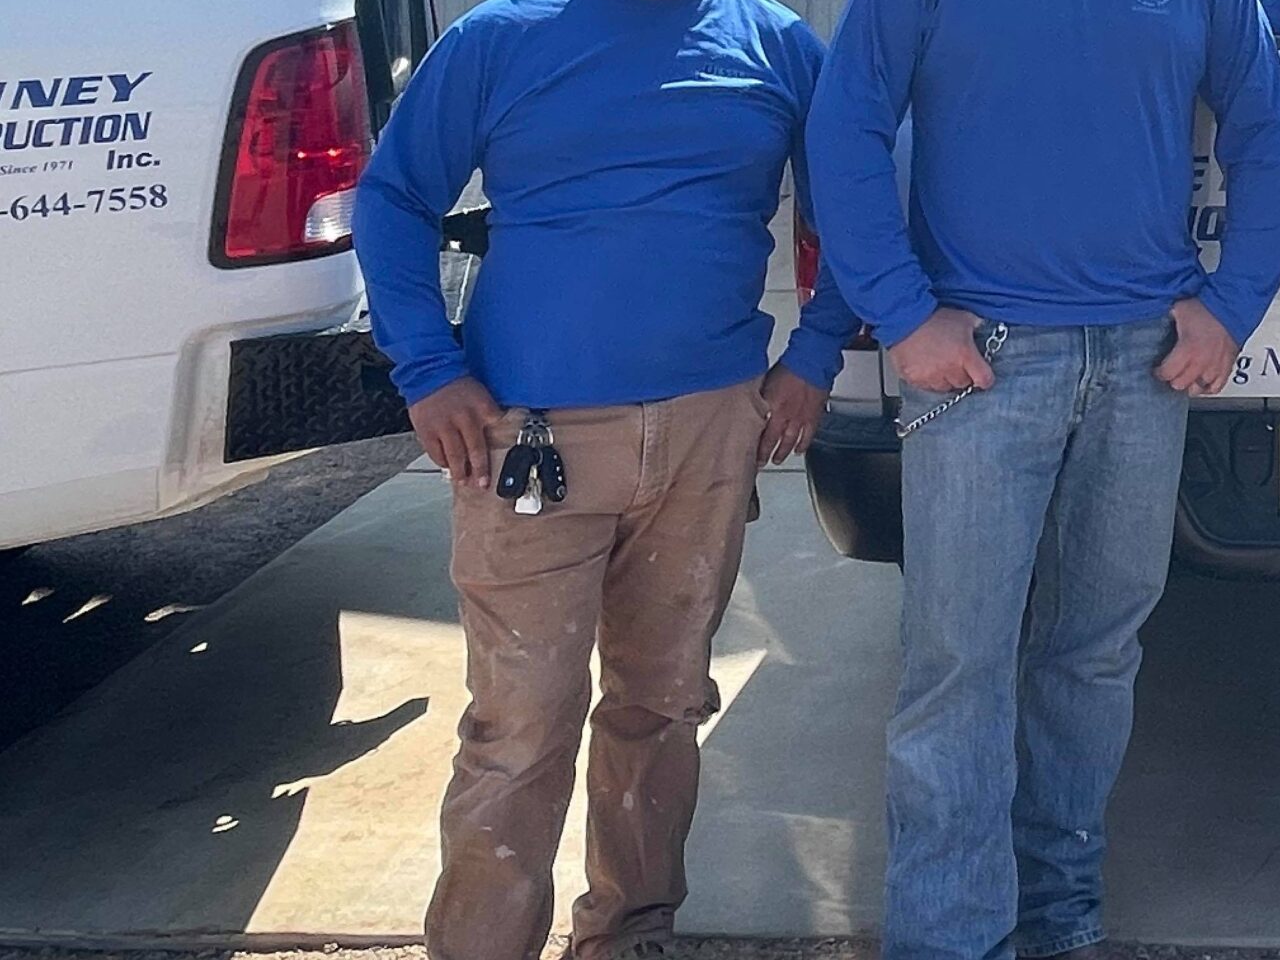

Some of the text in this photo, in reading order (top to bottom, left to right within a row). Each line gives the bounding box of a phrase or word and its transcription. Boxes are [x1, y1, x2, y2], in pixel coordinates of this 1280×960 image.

[0, 71, 153, 110] NEY
[0, 111, 152, 150] UCTION
[0, 160, 74, 175] Since 1971
[107, 149, 161, 171] Inc.
